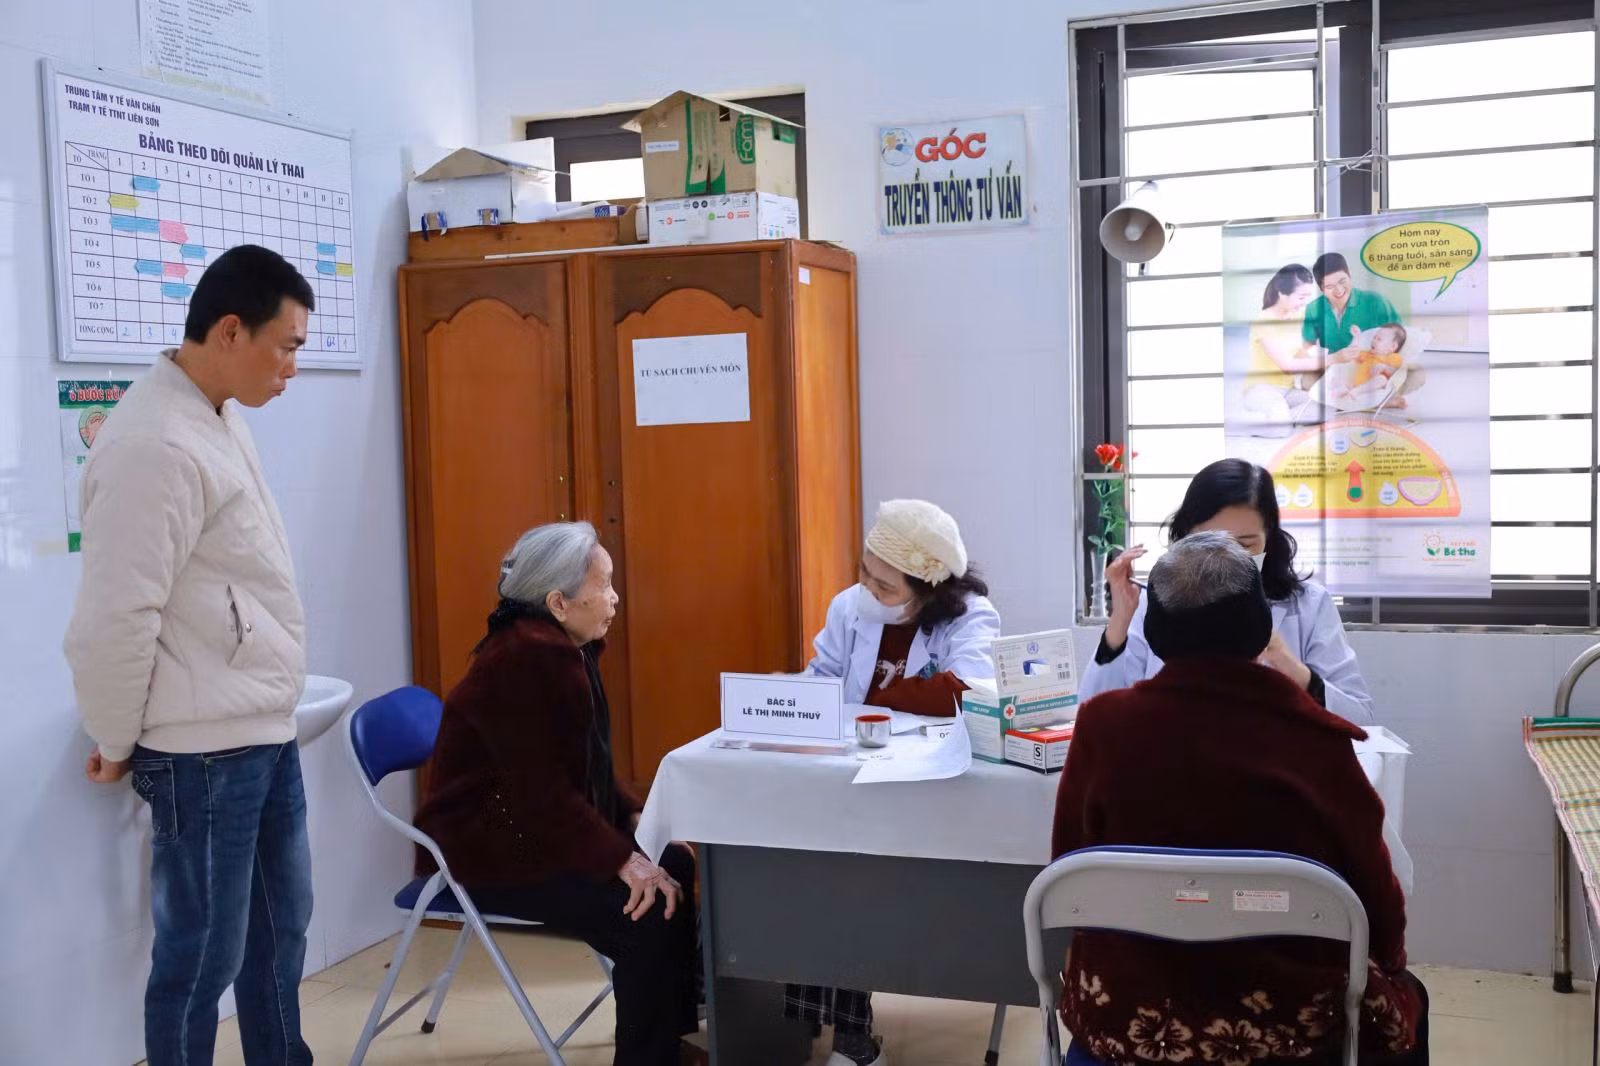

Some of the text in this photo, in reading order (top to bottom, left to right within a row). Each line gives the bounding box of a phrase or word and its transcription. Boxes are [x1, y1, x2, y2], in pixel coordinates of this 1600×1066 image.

[65, 84, 90, 97] TRUNG
[92, 90, 108, 102] TÂM
[110, 95, 114, 103] Y
[116, 95, 124, 105] TẾ
[69, 100, 90, 113] TRẠM
[98, 105, 107, 116] TẾ
[109, 109, 126, 120] TTNT
[128, 113, 143, 124] LIÊN
[145, 117, 160, 127] SƠN
[139, 130, 305, 179] BẢNG THEO DÕI QUẢN LÝ THAI
[914, 128, 986, 163] GÓC
[142, 161, 146, 170] 2
[165, 165, 169, 174] 3
[186, 170, 190, 178] 4
[934, 169, 973, 223] THÔNG
[976, 167, 992, 220] TƯ
[996, 160, 1022, 219] VẤN
[654, 366, 678, 377] SÁCH
[680, 364, 718, 376] CHUYÊN
[720, 362, 741, 373] MÔN
[767, 696, 785, 706] BÁC
[742, 706, 752, 715] LÊ
[755, 708, 769, 718] THỊ
[771, 710, 795, 718] MINH
[1035, 746, 1041, 758] S
